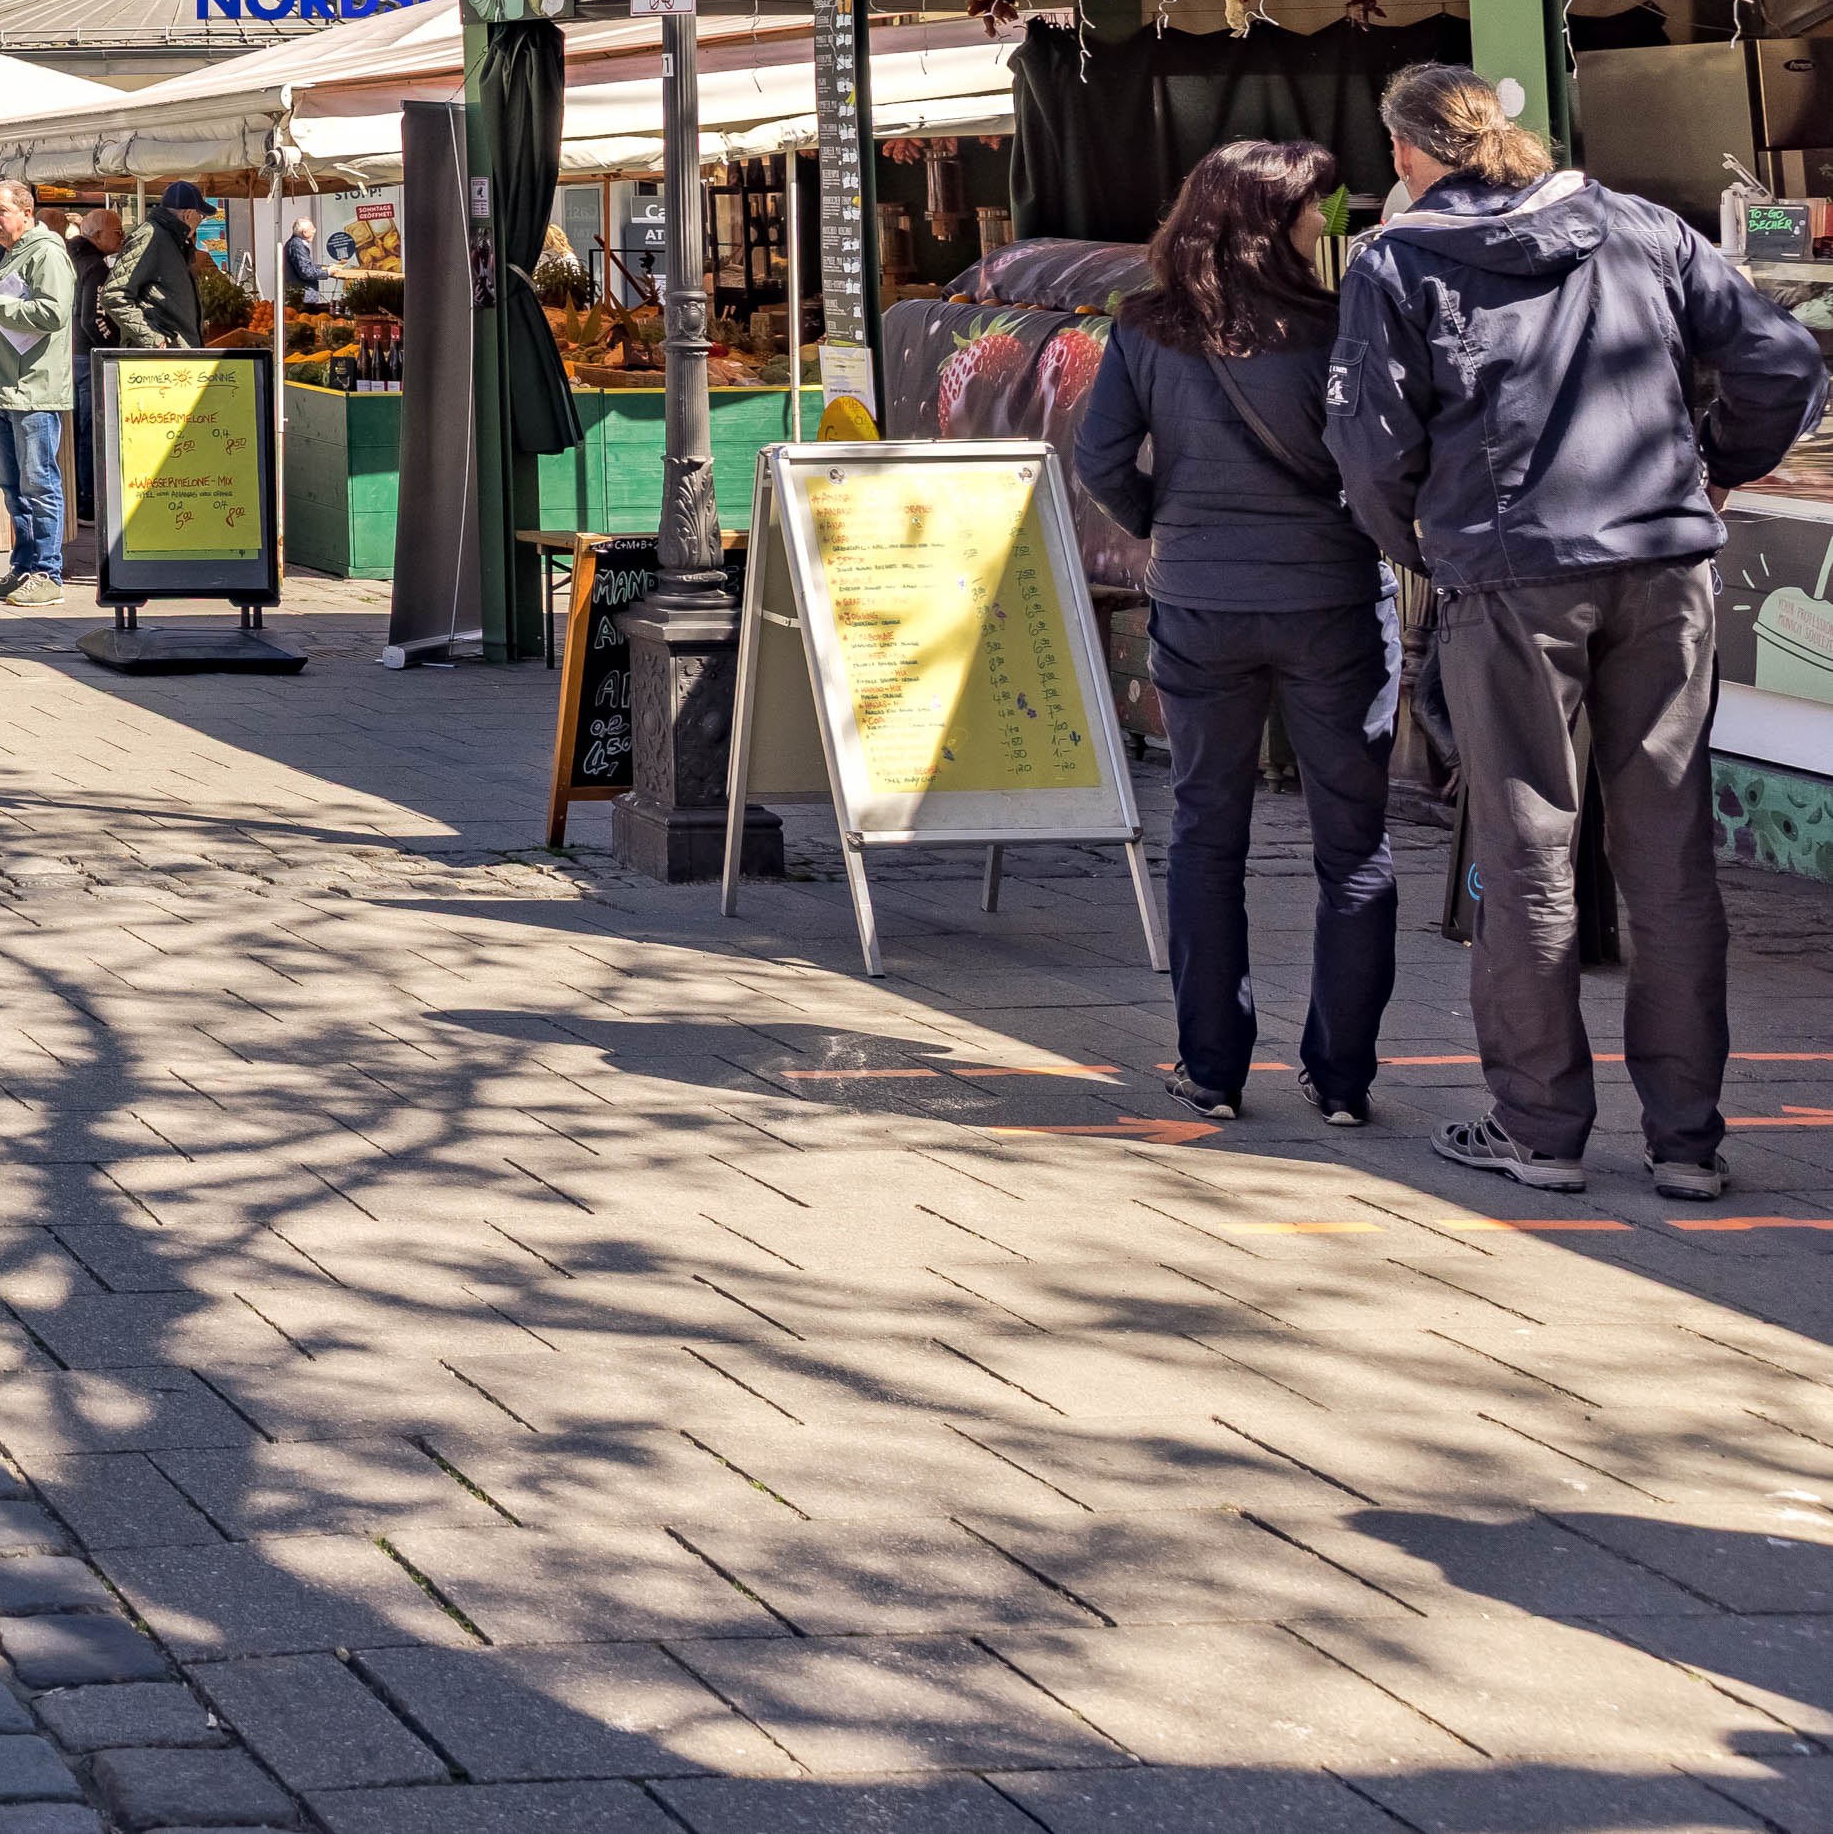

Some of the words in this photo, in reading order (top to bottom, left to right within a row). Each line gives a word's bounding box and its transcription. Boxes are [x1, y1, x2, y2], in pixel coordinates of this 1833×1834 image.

[358, 205, 391, 213] SONNTAGS
[1748, 208, 1784, 219] TO-GO
[359, 211, 393, 219] GEÖFFNET!
[1748, 218, 1793, 232] BECHER
[645, 229, 665, 240] AT
[127, 372, 173, 384] SOMMER
[197, 370, 237, 383] SONNE
[130, 411, 219, 424] WASSERMELONE
